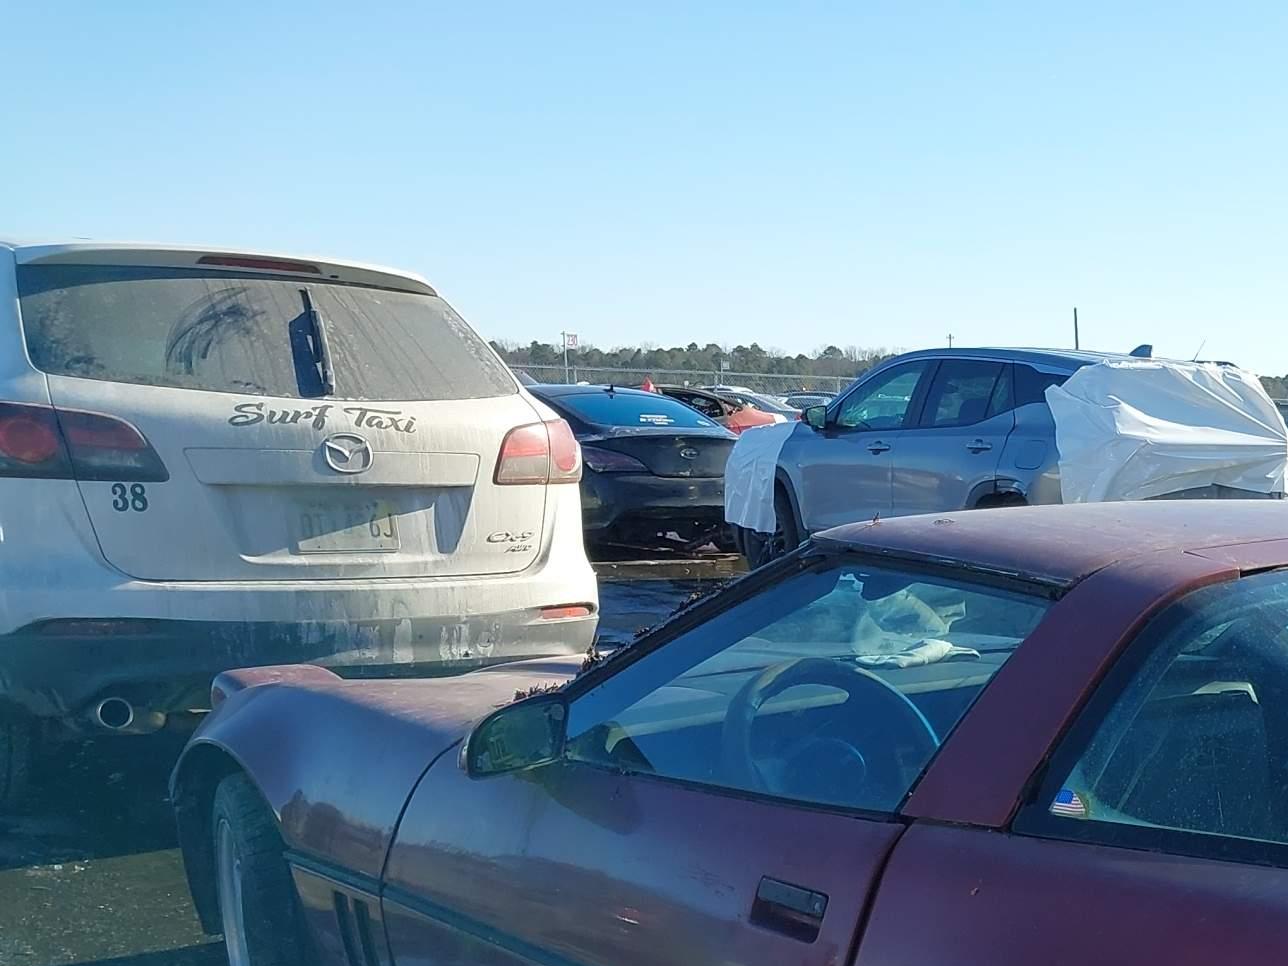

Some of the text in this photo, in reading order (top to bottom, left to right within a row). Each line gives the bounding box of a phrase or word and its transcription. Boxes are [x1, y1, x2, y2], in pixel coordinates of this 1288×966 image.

[228, 402, 417, 433] Surf Taxi
[111, 483, 149, 512] 38
